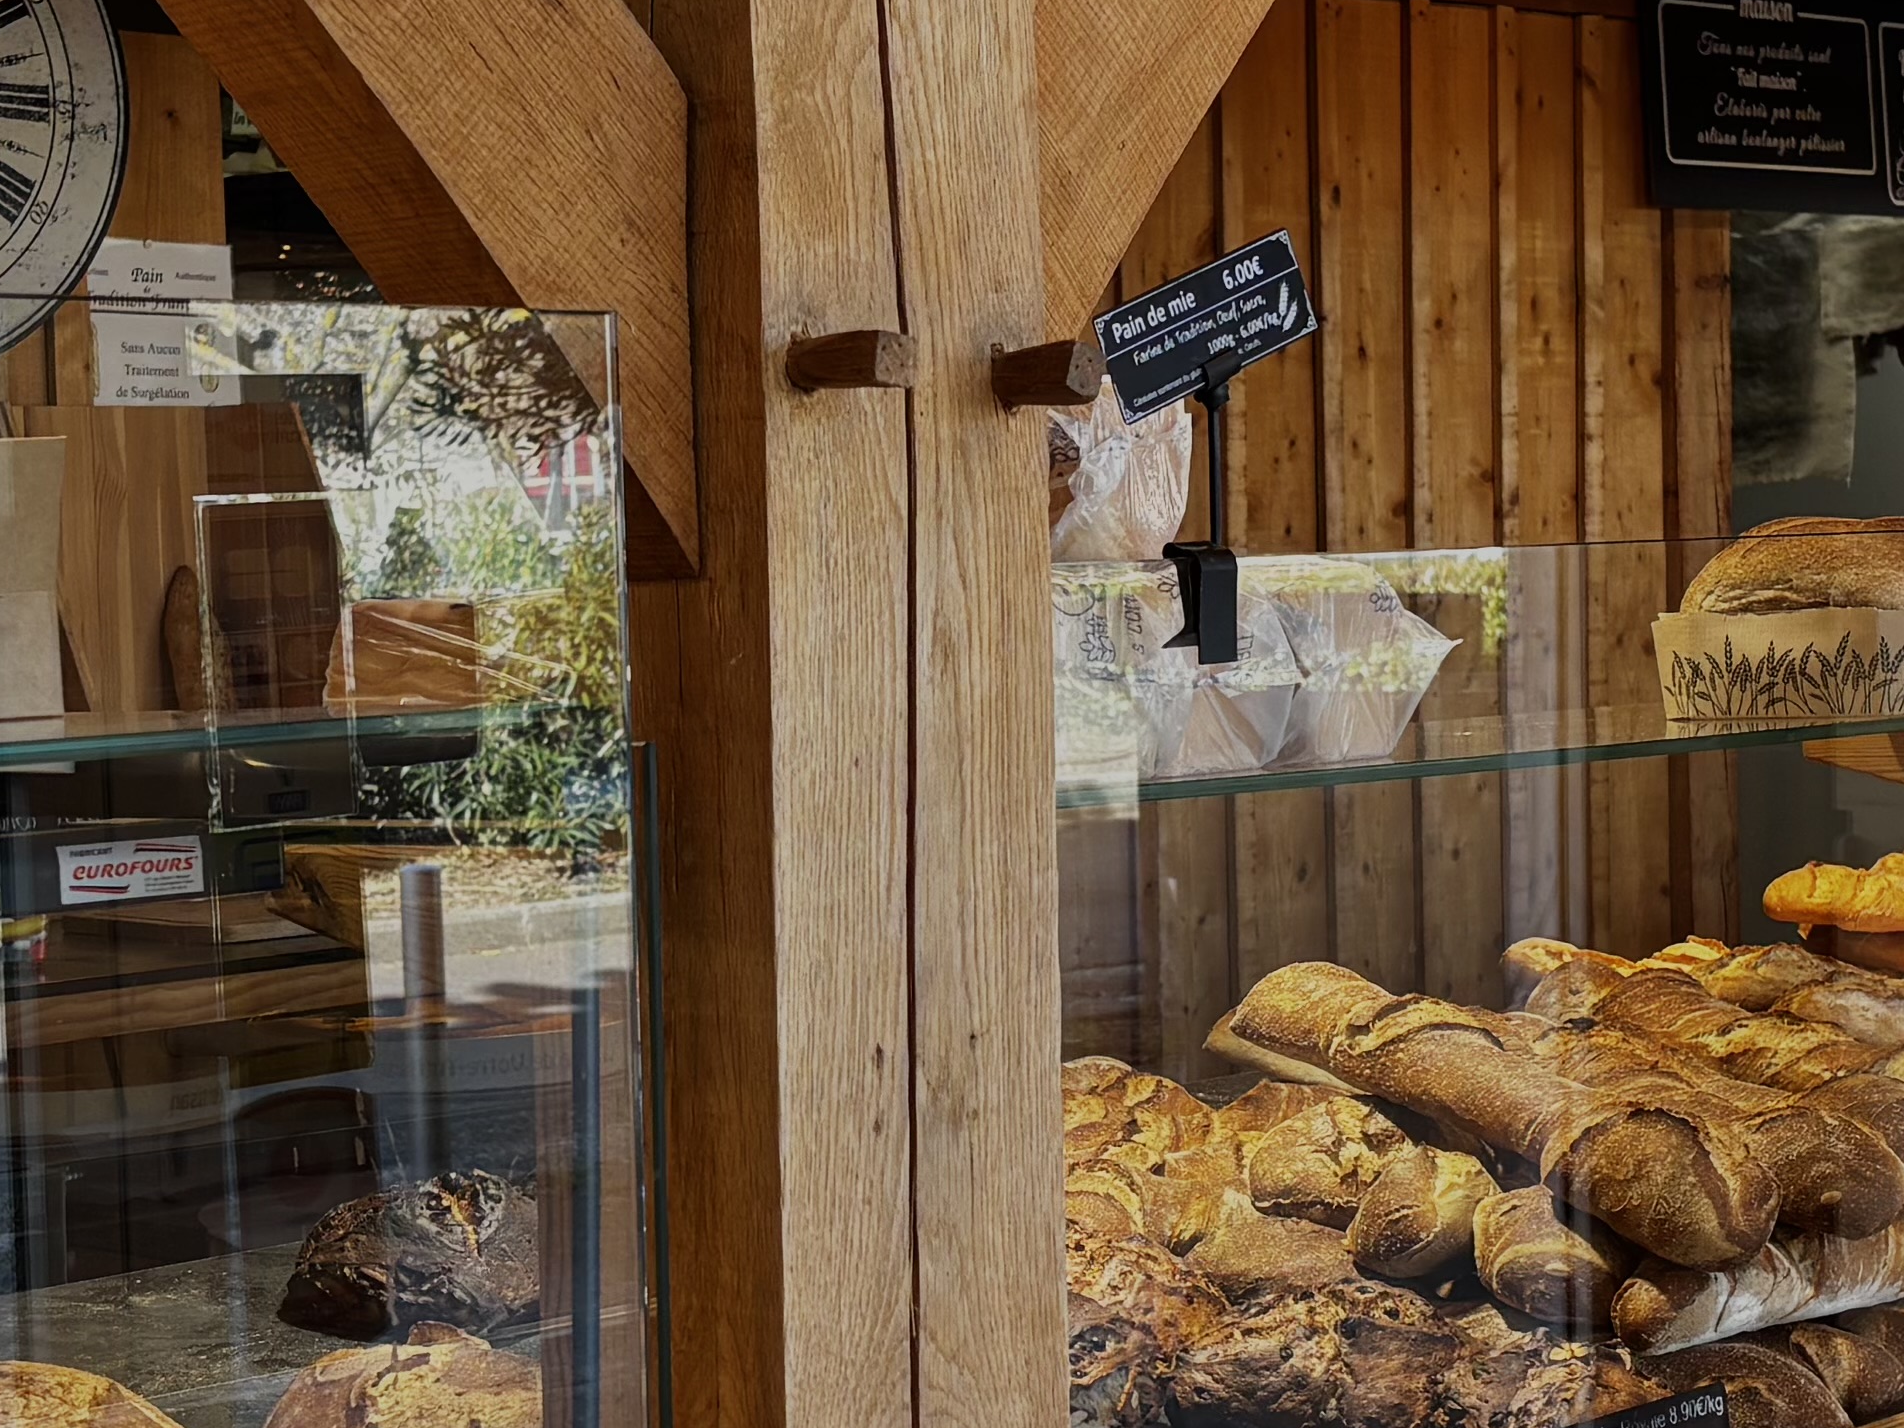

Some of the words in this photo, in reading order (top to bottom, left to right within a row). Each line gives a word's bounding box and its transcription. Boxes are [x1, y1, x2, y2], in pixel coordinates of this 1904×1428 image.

[131, 267, 163, 284] Pain
[1222, 255, 1264, 290] 6.00€
[1111, 314, 1147, 344] Pain
[1147, 304, 1166, 327] de
[1168, 290, 1197, 317] mie
[116, 385, 128, 398] de
